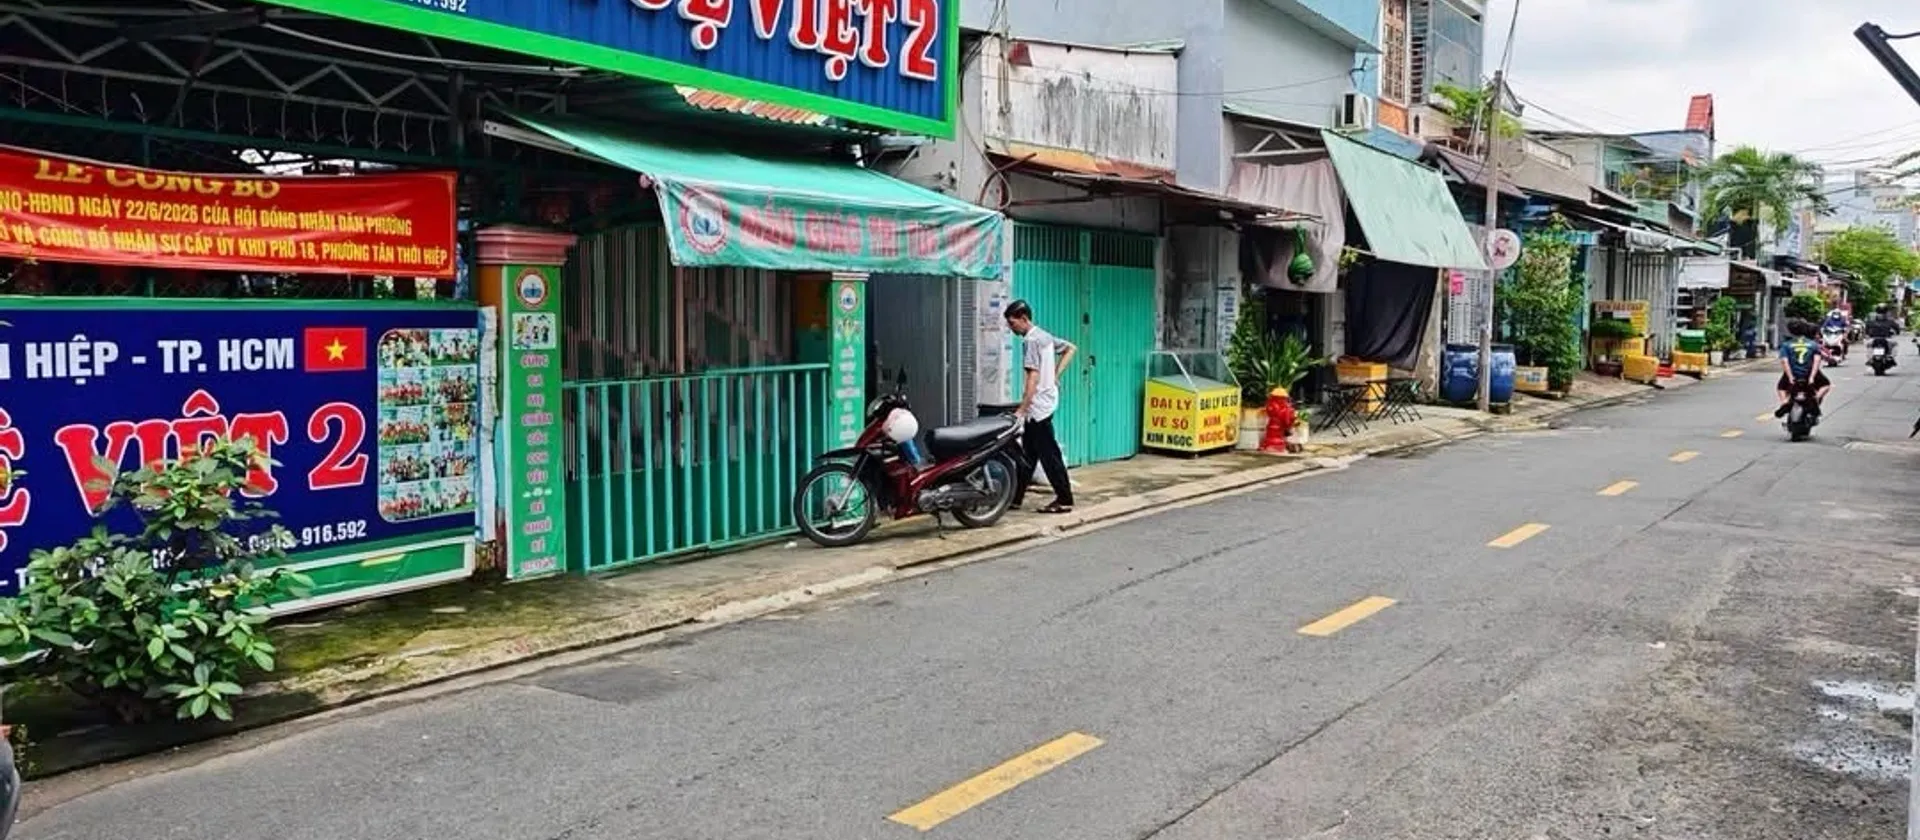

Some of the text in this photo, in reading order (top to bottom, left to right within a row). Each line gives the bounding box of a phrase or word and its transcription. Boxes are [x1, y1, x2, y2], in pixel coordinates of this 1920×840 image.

[900, 0, 938, 81] 2
[78, 193, 121, 219] NGÀY
[126, 199, 198, 223] 22/6/2026
[234, 205, 257, 229] HỘI
[12, 221, 36, 245] VÀ
[113, 229, 156, 253] NHÂN
[160, 232, 180, 257] SỰ
[238, 238, 266, 257] KHU
[322, 239, 370, 262] PHƯỜNG
[373, 242, 394, 263] TÂN
[423, 244, 448, 269] HIỆP
[25, 334, 118, 385] HIỆP
[157, 340, 206, 373] TP.
[219, 338, 294, 371] HCM
[307, 401, 369, 490] 2
[1146, 433, 1164, 444] KIM
[1204, 415, 1221, 428] KIM
